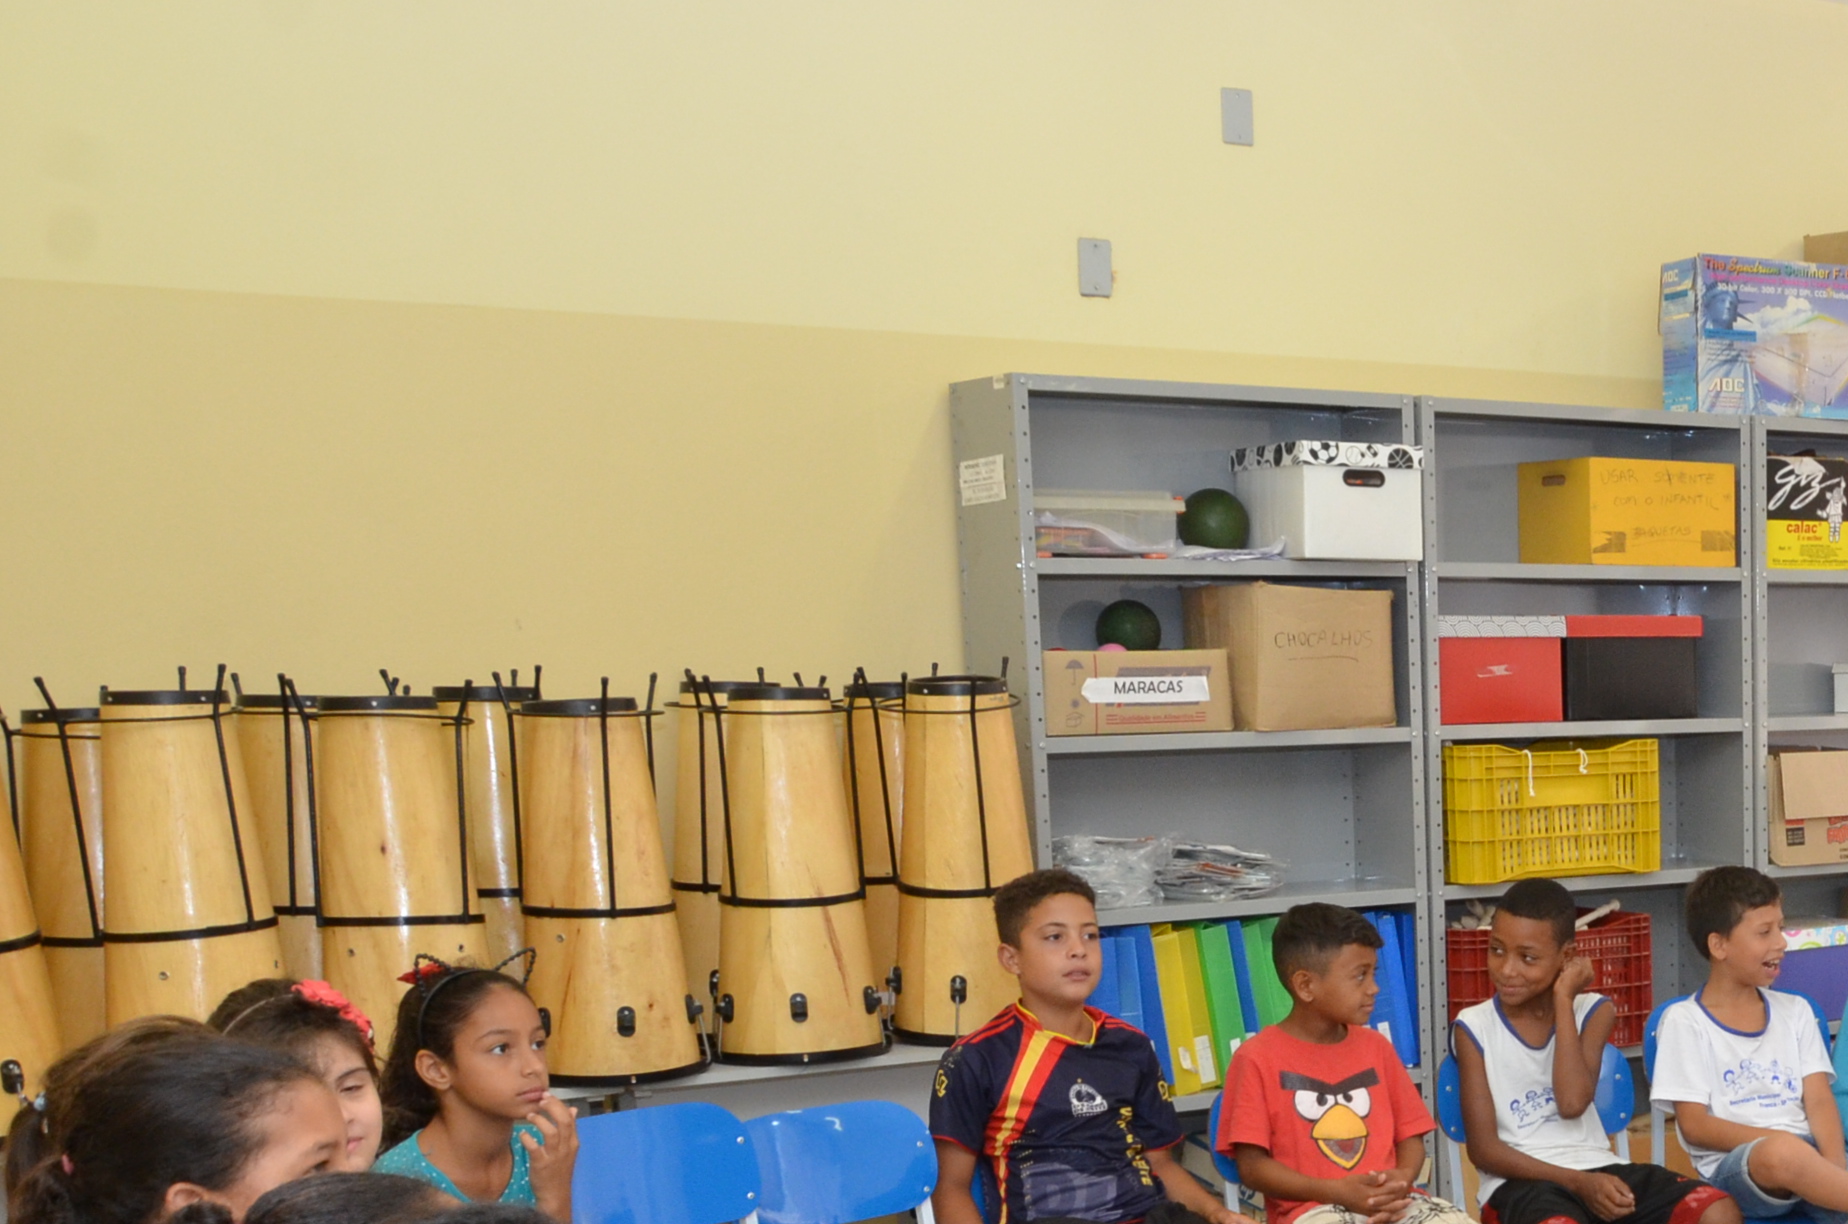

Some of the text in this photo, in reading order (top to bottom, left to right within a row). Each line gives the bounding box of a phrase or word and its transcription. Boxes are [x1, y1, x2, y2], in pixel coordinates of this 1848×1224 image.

[1703, 256, 1726, 272] The
[1728, 257, 1781, 276] Spectrum
[1662, 269, 1679, 282] AOC
[1708, 377, 1745, 393] AOC
[1600, 468, 1639, 485] USAR
[1786, 520, 1818, 534] calac
[1274, 630, 1374, 649] CHOCALHOS
[1113, 680, 1184, 695] MARACAS
